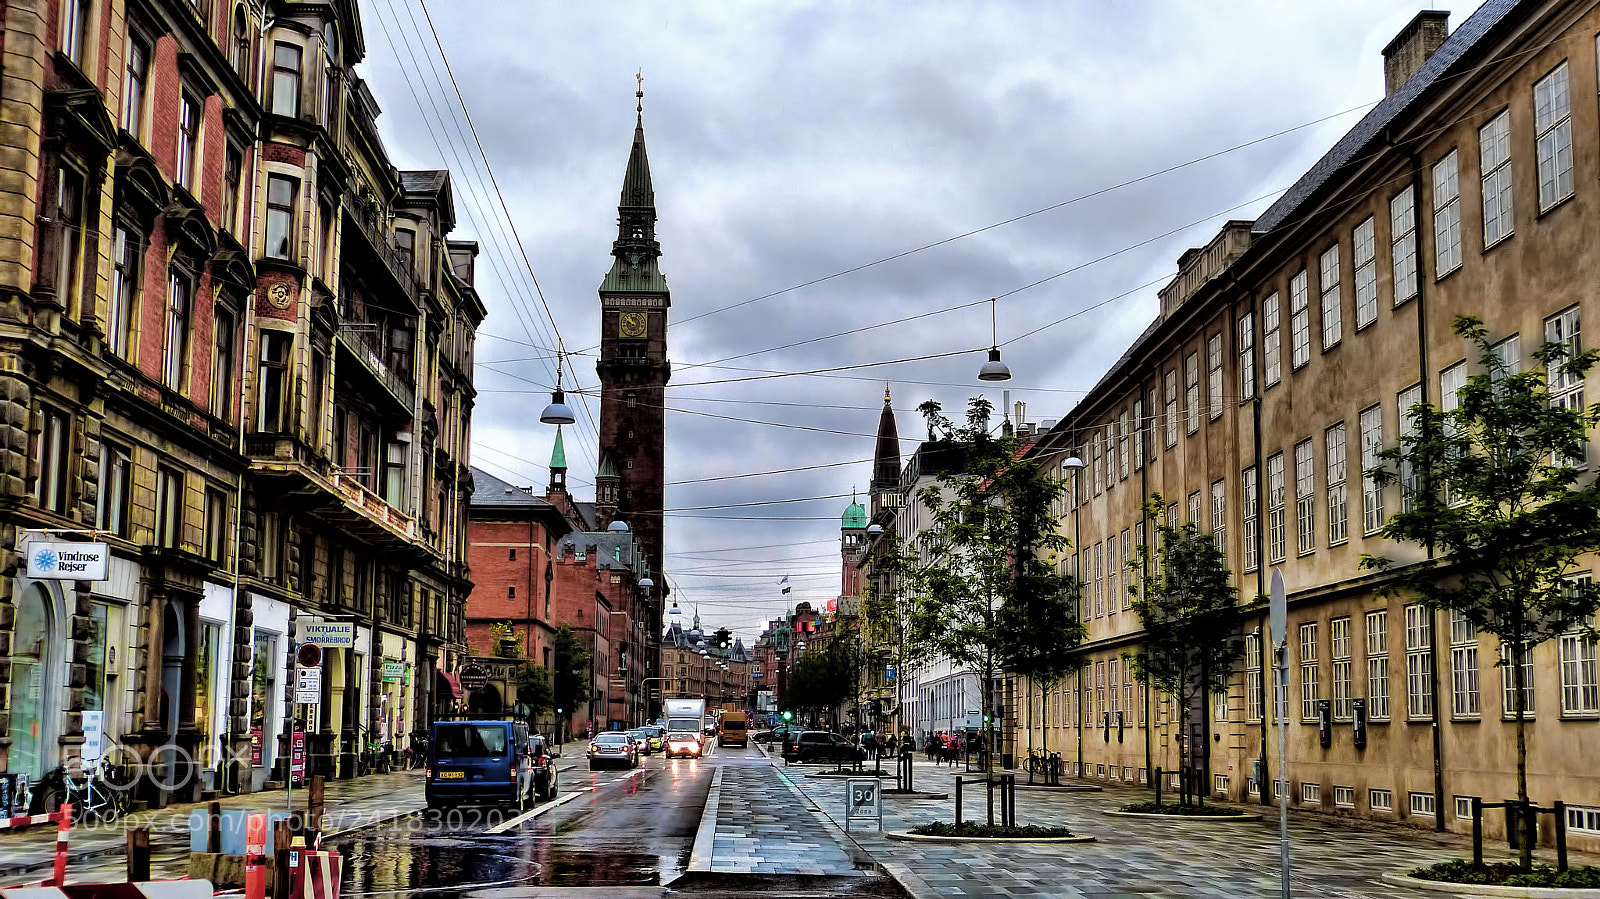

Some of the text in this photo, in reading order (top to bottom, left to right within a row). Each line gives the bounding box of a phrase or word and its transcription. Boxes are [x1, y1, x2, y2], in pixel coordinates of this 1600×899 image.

[881, 493, 906, 508] HOTEL
[58, 551, 99, 562] Vindrose
[58, 562, 87, 572] Rejser
[306, 625, 350, 633] VIKTUALIE
[854, 790, 874, 802] 30
